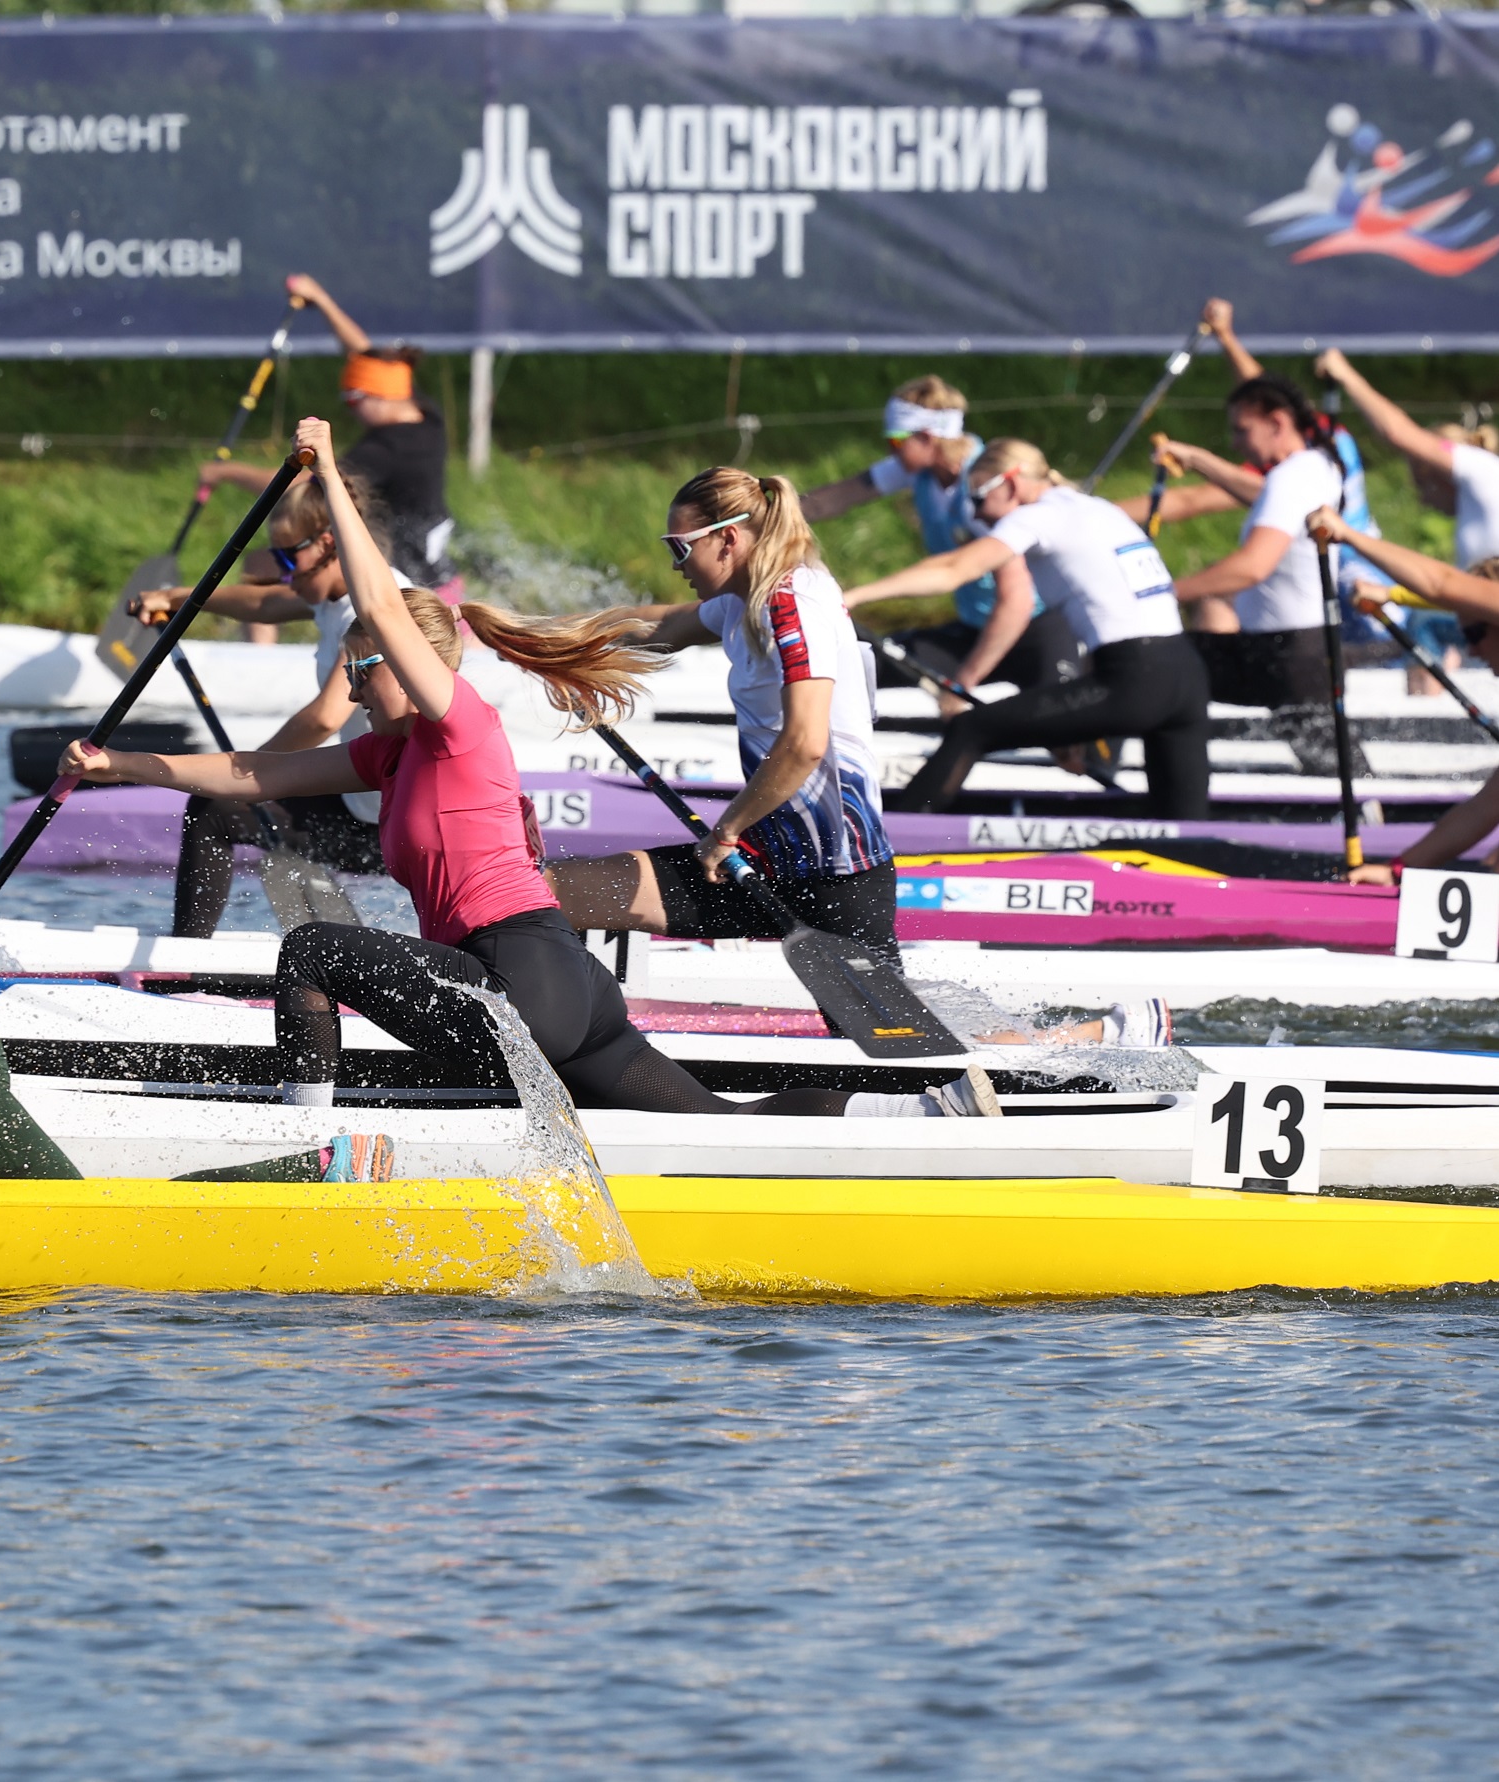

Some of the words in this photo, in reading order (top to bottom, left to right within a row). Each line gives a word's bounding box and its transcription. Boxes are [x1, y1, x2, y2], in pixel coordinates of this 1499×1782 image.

[608, 90, 1048, 192] МОСКОВСКИЙ
[37, 231, 241, 278] Москвы
[607, 194, 816, 278] СПОРТ
[531, 794, 585, 826] US
[1006, 884, 1088, 911] BLR
[1437, 877, 1472, 949] 9
[1211, 1081, 1305, 1179] 13
